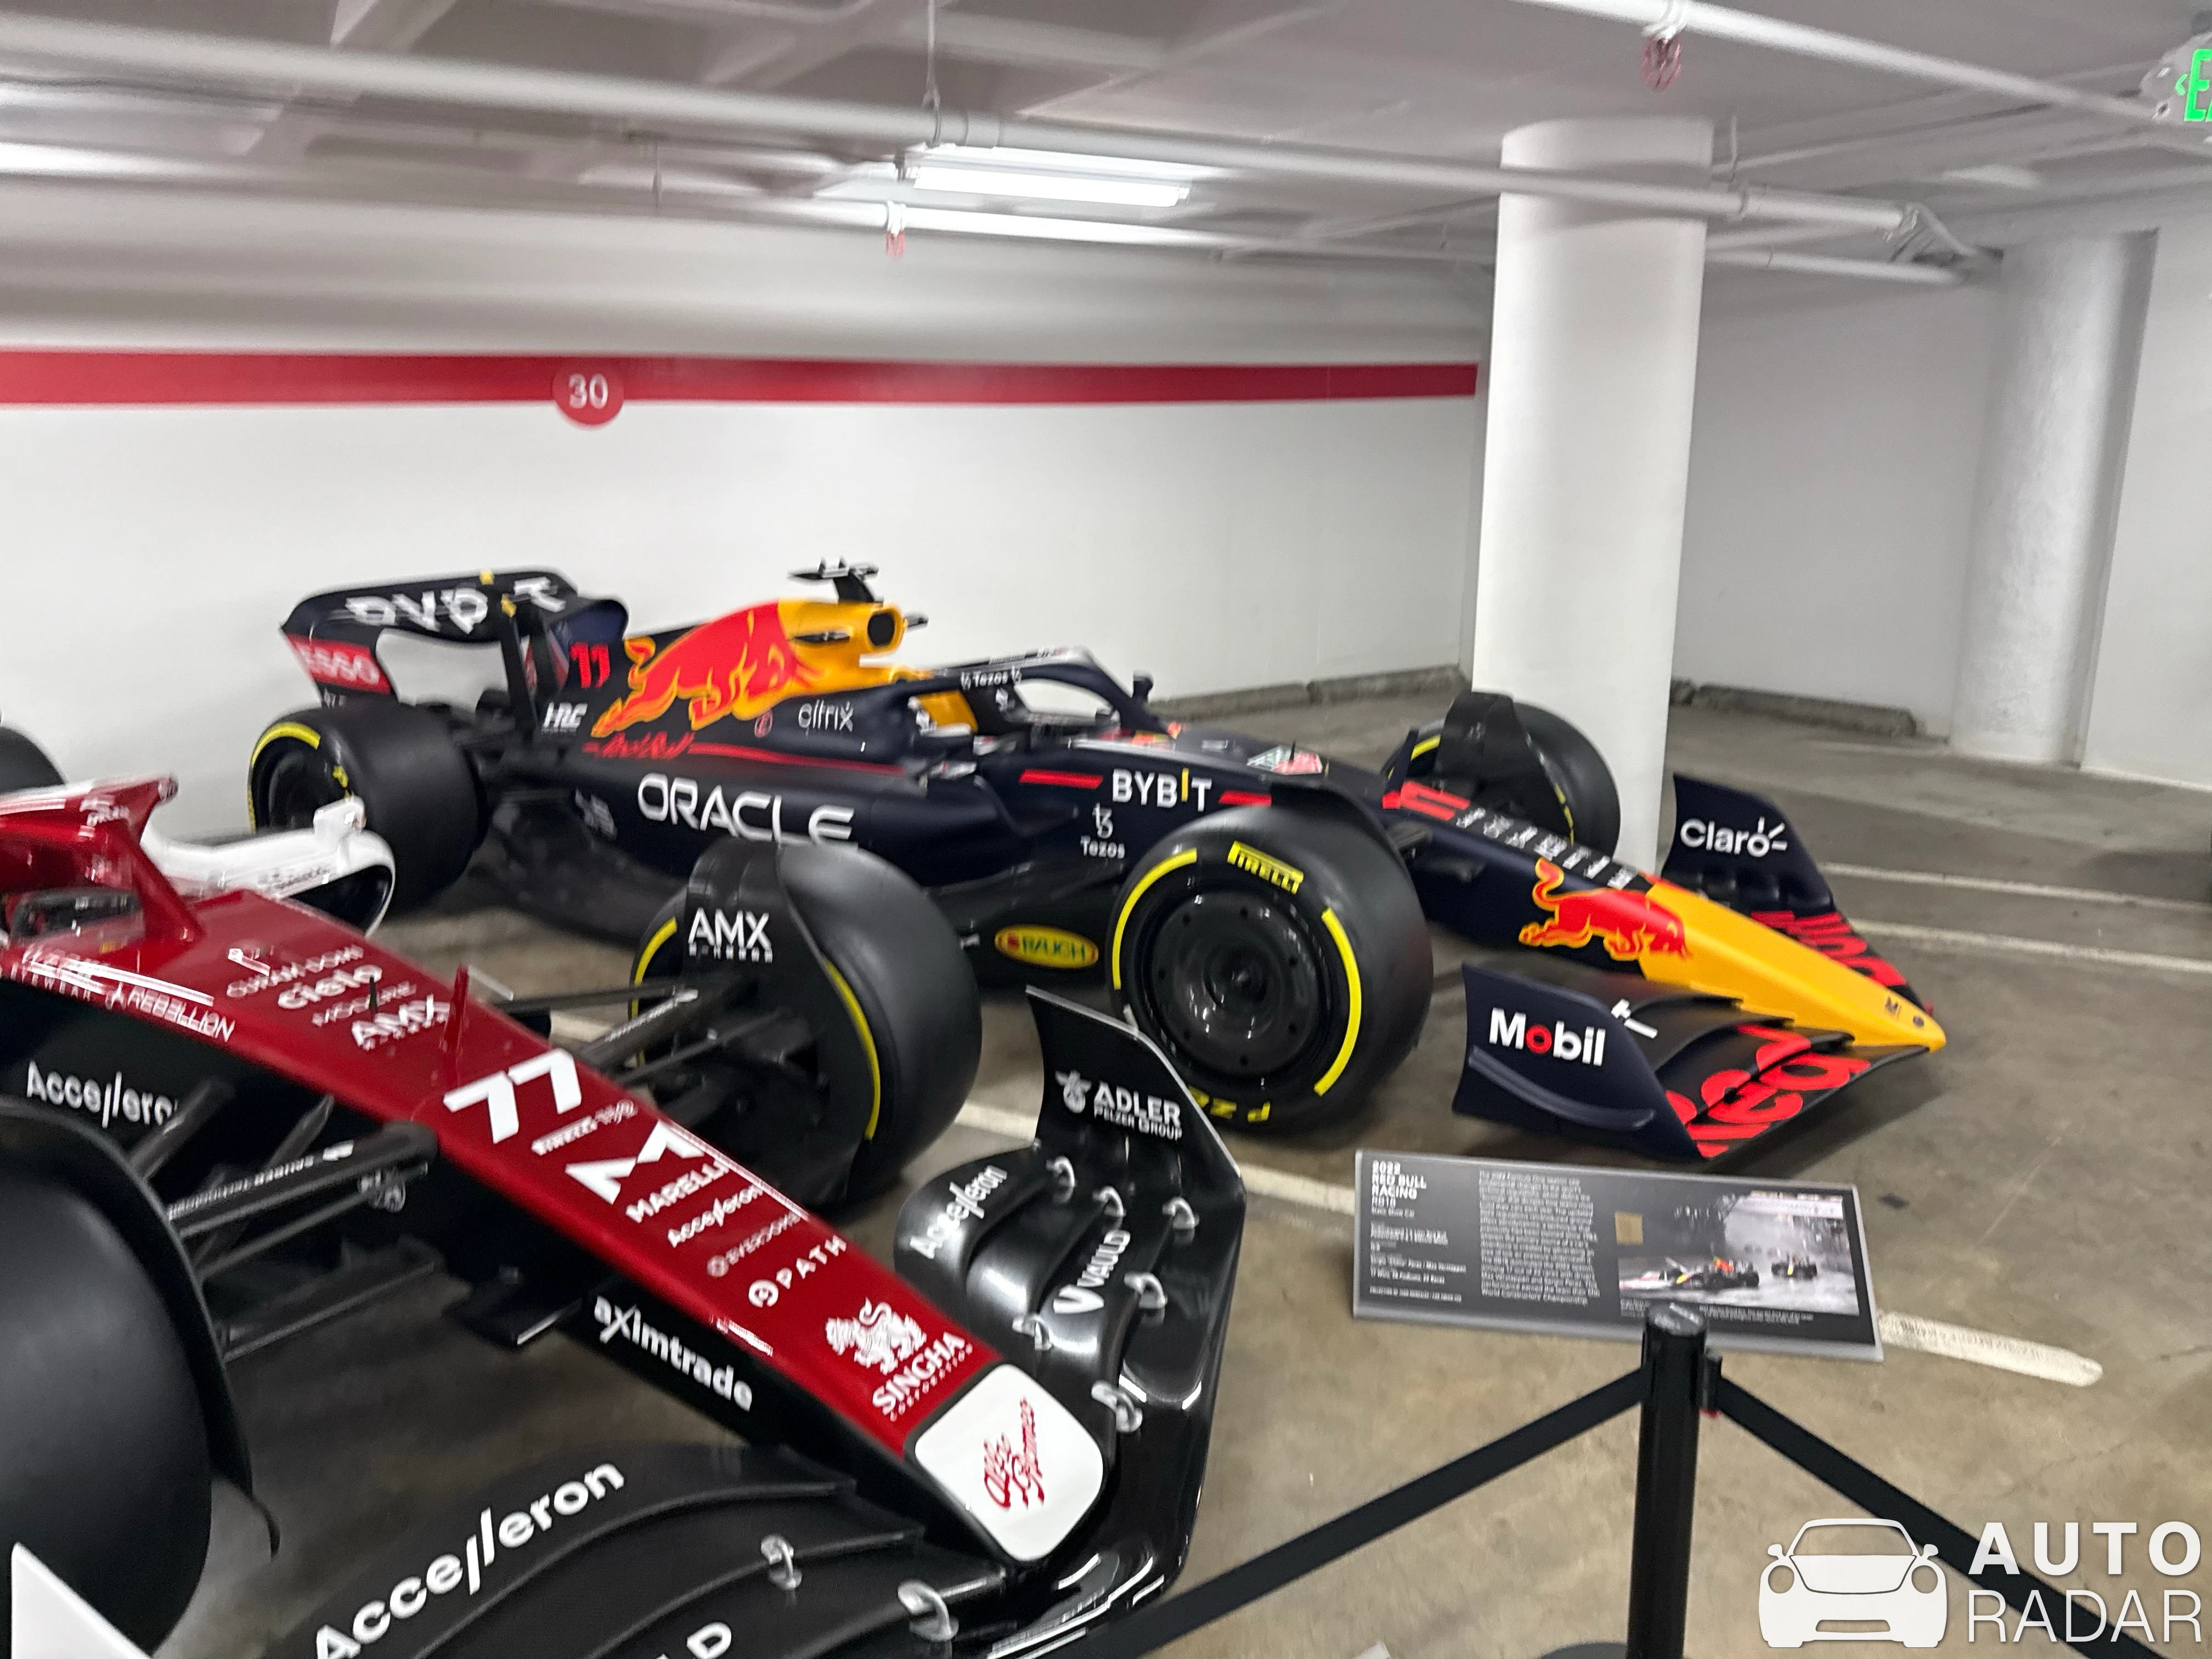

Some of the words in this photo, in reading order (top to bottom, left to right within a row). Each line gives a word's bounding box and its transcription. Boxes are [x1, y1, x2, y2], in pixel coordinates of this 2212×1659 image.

[568, 373, 608, 409] 30
[569, 641, 611, 689] 11
[637, 772, 859, 849] ORACLE
[1112, 768, 1213, 812] BYBIT
[1680, 816, 1780, 858] Claro
[688, 907, 772, 952] AMX
[1489, 1007, 1606, 1067] Mobil
[26, 1059, 179, 1128] Accellero
[443, 1047, 583, 1145] 77
[1094, 1081, 1181, 1128] ADLER
[775, 1234, 847, 1290] PATH
[594, 1295, 753, 1412] eximtrade
[872, 1331, 966, 1416] SINGHA
[316, 1463, 625, 1659] Accelleron
